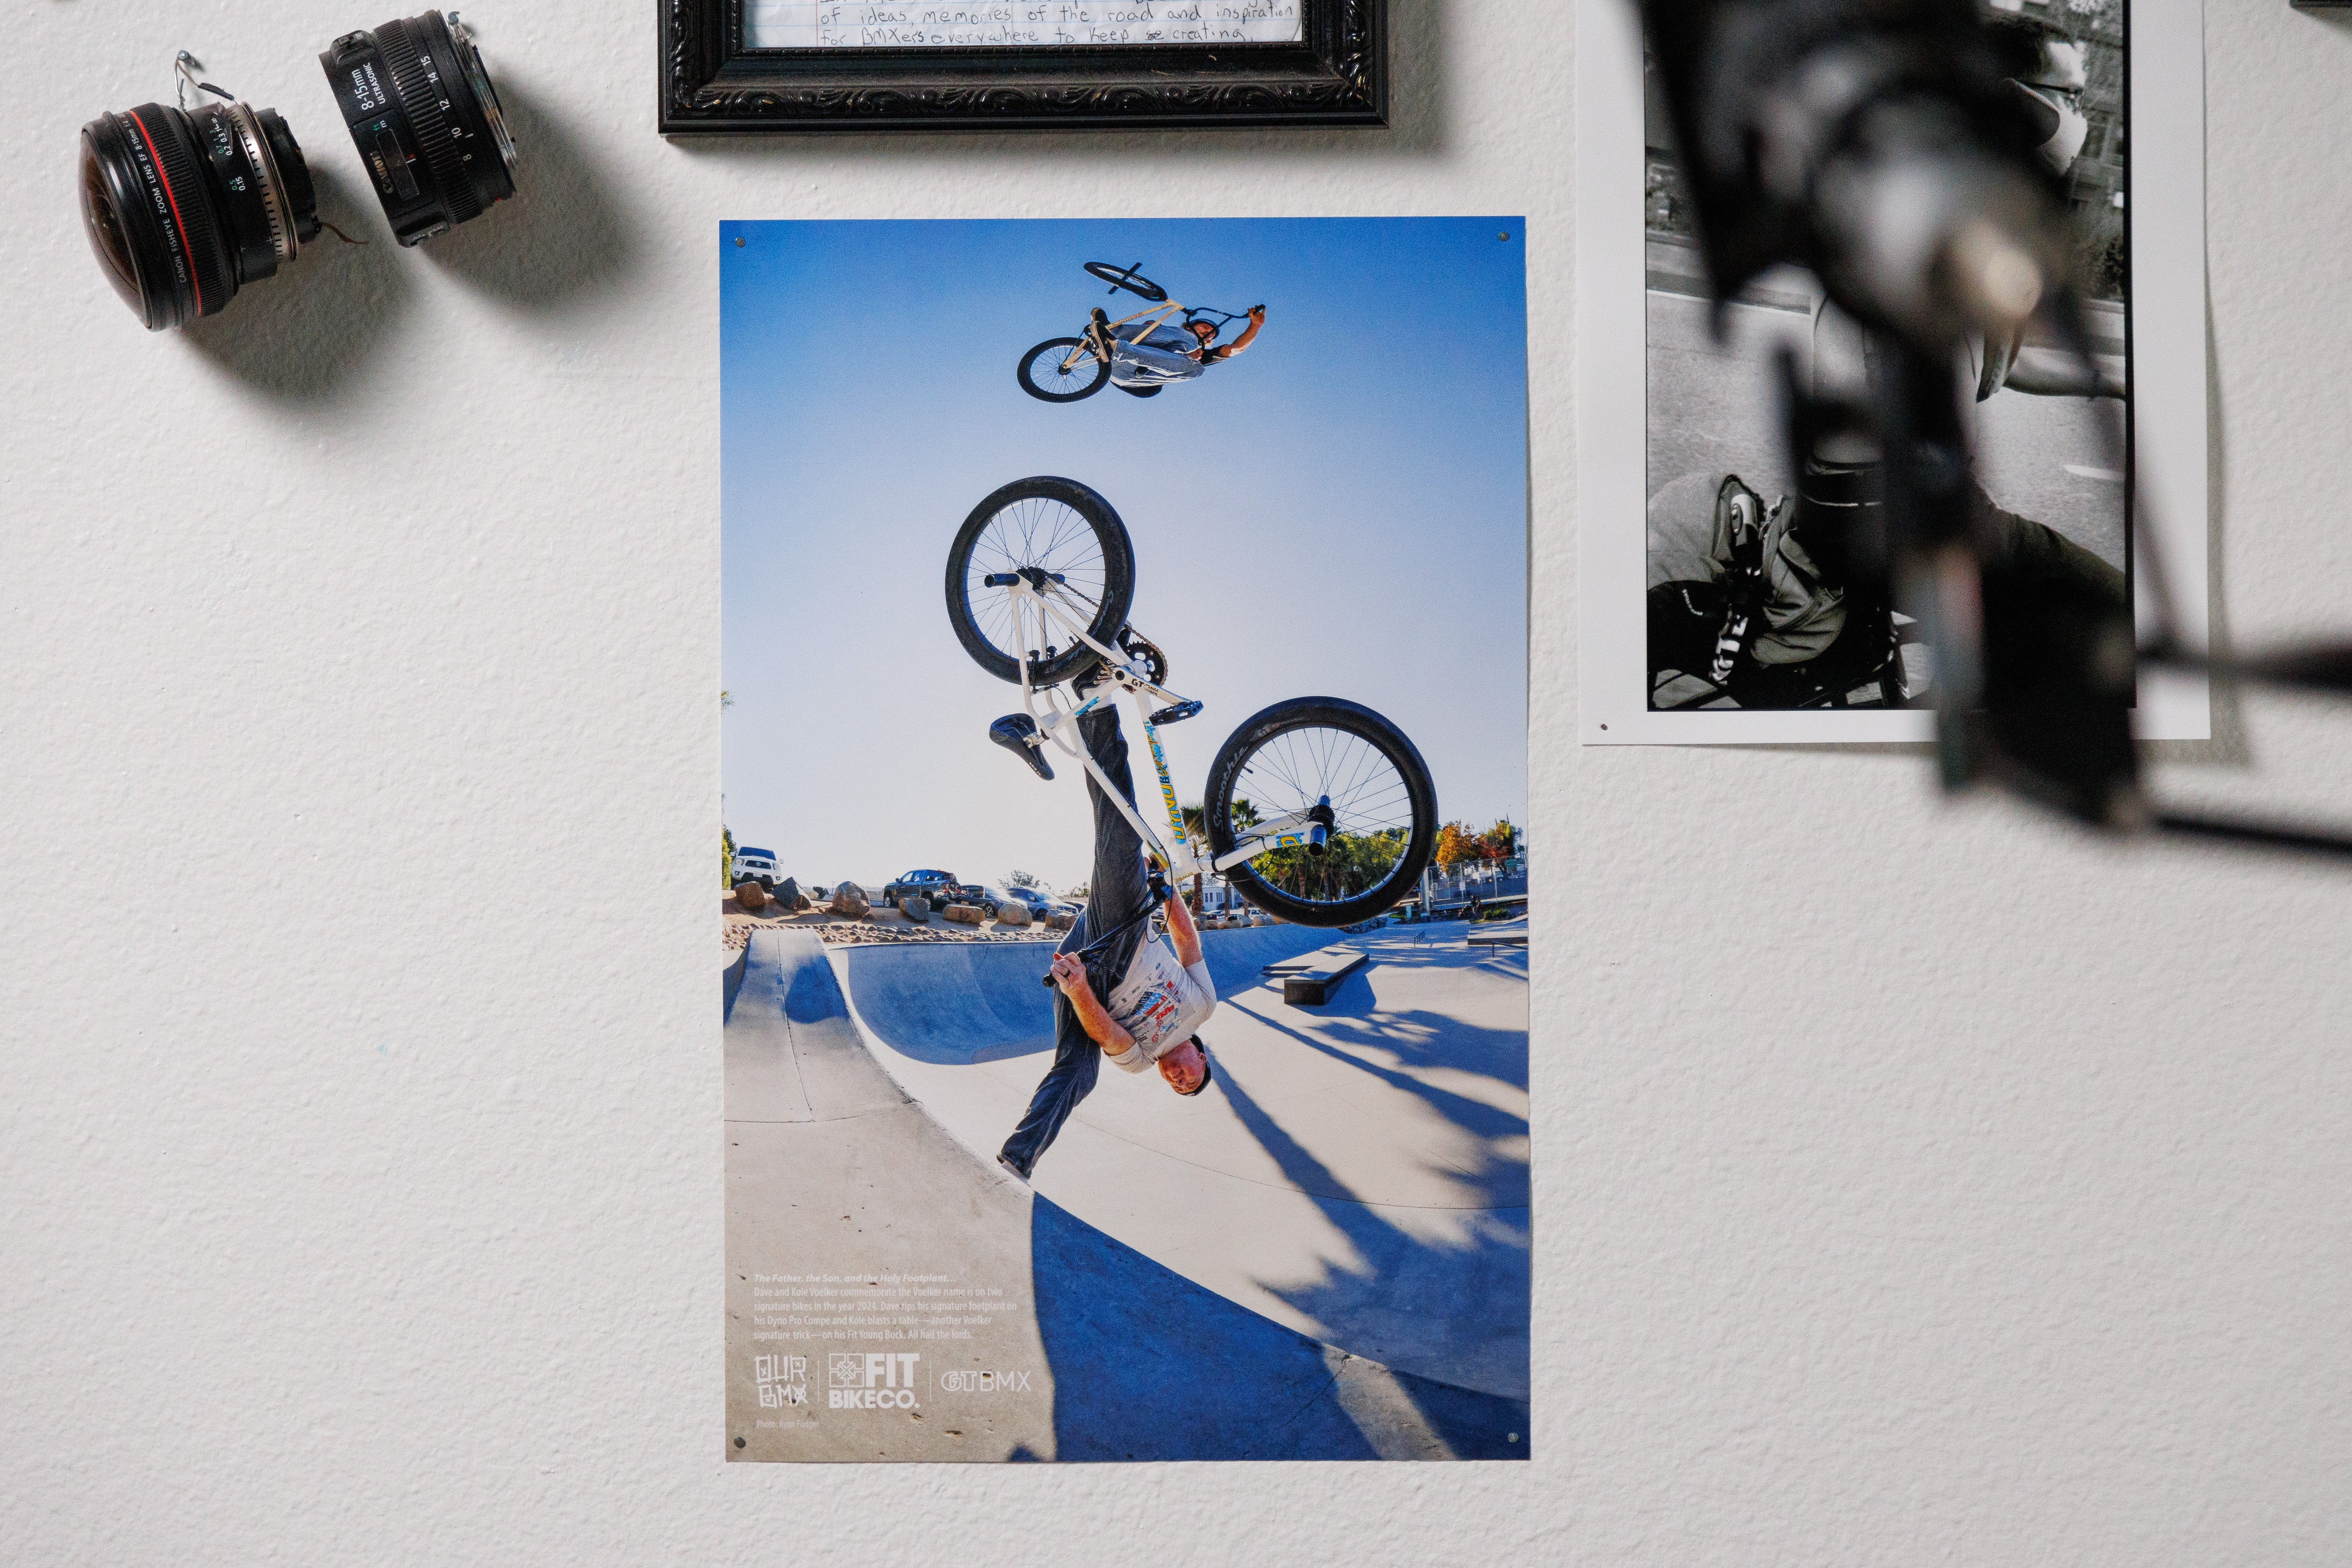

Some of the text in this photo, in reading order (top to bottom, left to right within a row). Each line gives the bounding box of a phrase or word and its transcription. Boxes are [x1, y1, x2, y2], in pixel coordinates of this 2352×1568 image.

[821, 7, 840, 25] of
[923, 8, 1011, 25] memories
[1028, 5, 1046, 22] of
[1060, 5, 1090, 22] the
[1108, 3, 1153, 22] road
[1167, 5, 1202, 21] and
[821, 29, 846, 45] for
[931, 25, 1038, 45] everywhere
[1054, 26, 1074, 45] to
[421, 56, 431, 66] 15
[363, 62, 386, 104] ULTRASONIC
[428, 72, 438, 83] 14
[352, 69, 374, 110] 8-15mm
[439, 98, 450, 111] 12
[452, 127, 462, 138] 10
[224, 145, 233, 156] 0.2
[138, 153, 147, 162] EF
[143, 165, 156, 183] LENS
[235, 176, 245, 191] 0.15
[152, 187, 167, 214] ZOOM
[163, 218, 178, 252] FISHEYE
[755, 1274, 770, 1282] The
[806, 1274, 820, 1282] the
[844, 1274, 862, 1282] and
[864, 1274, 878, 1282] the
[880, 1274, 900, 1284] Holy
[754, 1287, 773, 1296] Dave
[775, 1287, 789, 1296] and
[791, 1287, 808, 1296] Kole
[809, 1287, 838, 1296] Voelker
[840, 1287, 896, 1297] commemorate
[898, 1287, 911, 1296] the
[913, 1287, 942, 1296] Voelker
[967, 1287, 973, 1296] is
[987, 1288, 1002, 1296] two
[753, 1302, 790, 1313] signature
[792, 1301, 812, 1311] bikes
[814, 1302, 821, 1311] in
[824, 1302, 836, 1311] the
[838, 1303, 855, 1312] year
[857, 1302, 878, 1311] 2024.
[881, 1302, 899, 1310] Dave
[902, 1302, 915, 1312] rips
[917, 1302, 929, 1310] his
[931, 1302, 967, 1312] signature
[969, 1301, 1005, 1312] footplant
[754, 1316, 765, 1325] his
[767, 1316, 787, 1327] Dyno
[789, 1316, 802, 1325] Pro
[804, 1316, 830, 1327] Compe
[832, 1316, 847, 1325] and
[849, 1316, 866, 1325] Kole
[867, 1316, 890, 1325] blasts
[963, 1315, 992, 1325] Voelker
[753, 1330, 790, 1341] signature
[834, 1330, 845, 1339] his
[848, 1330, 857, 1339] Fit
[859, 1330, 883, 1341] Young
[885, 1330, 906, 1339] Buck.
[908, 1330, 918, 1339] All
[920, 1330, 935, 1339] hail
[937, 1330, 949, 1339] the
[952, 1330, 973, 1339] lords.
[865, 1353, 920, 1388] FIT
